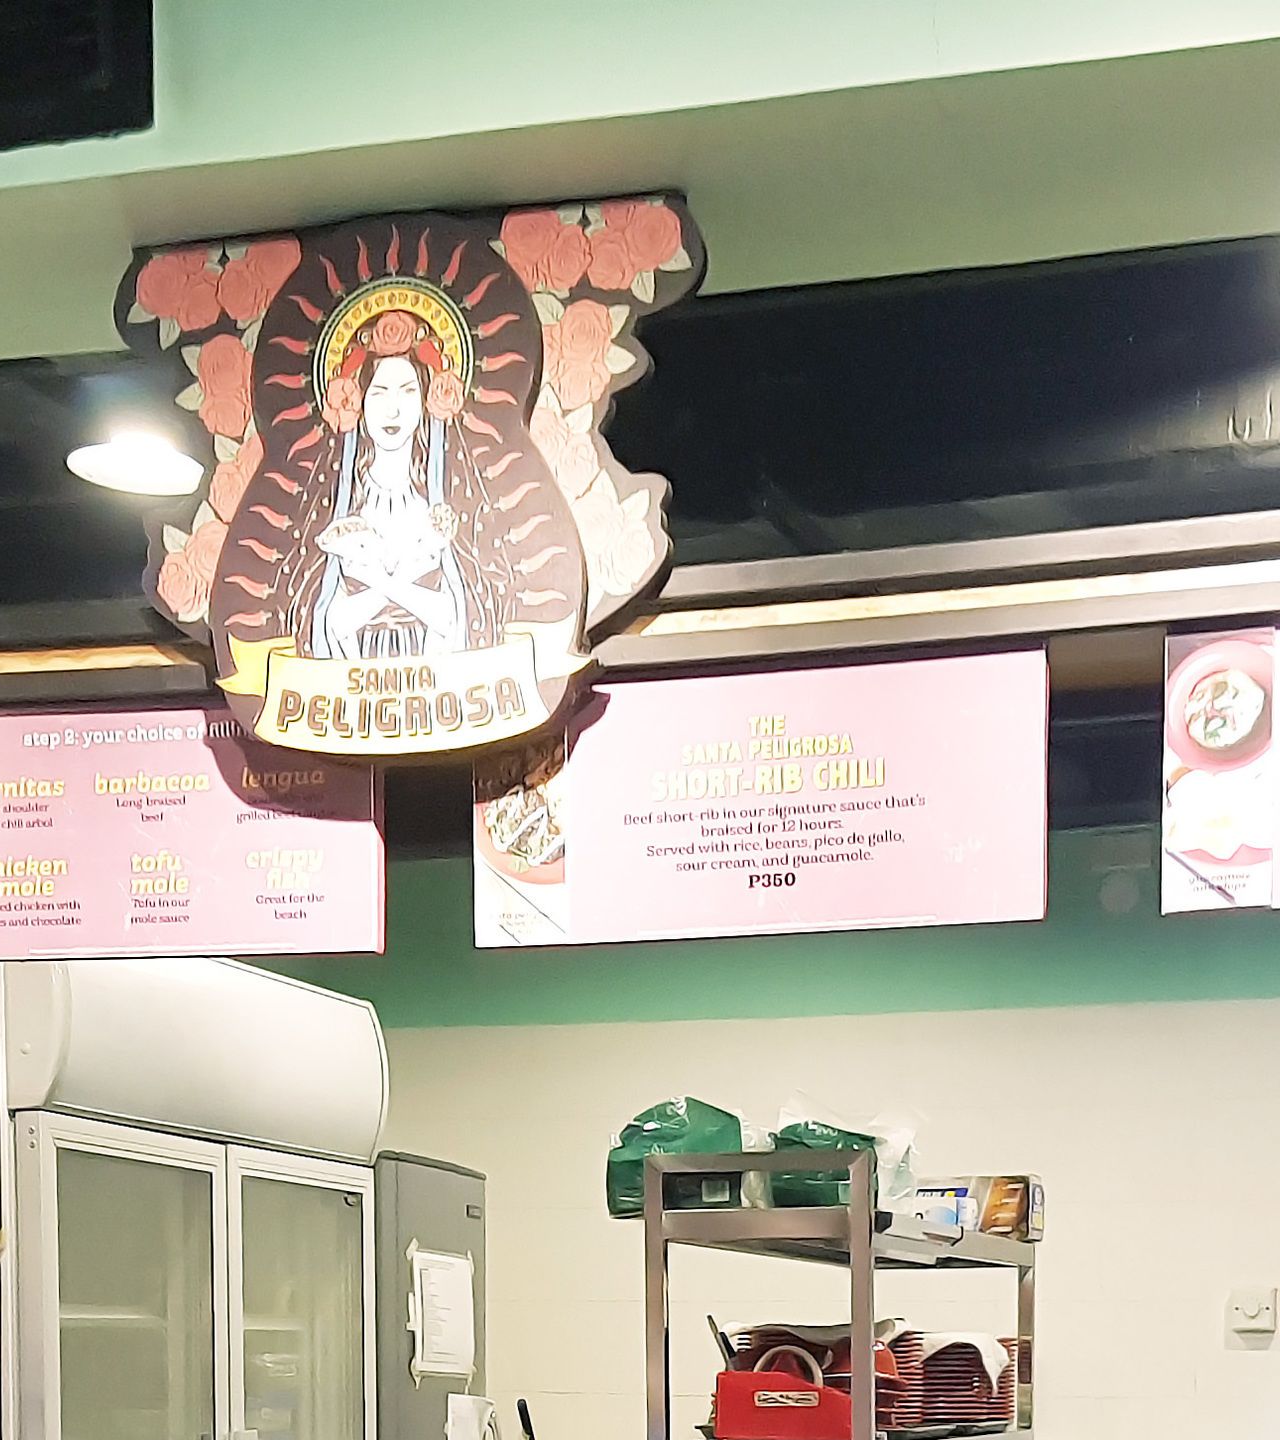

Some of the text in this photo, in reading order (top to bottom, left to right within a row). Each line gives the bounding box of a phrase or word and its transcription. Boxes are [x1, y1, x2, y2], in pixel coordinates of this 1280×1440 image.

[348, 665, 436, 695] SANTA
[276, 677, 526, 739] PELIGROSA
[23, 731, 61, 750] step
[64, 728, 80, 746] 2:
[81, 729, 122, 749] your
[126, 723, 183, 743] choice
[187, 721, 207, 740] of
[748, 714, 786, 737] THE
[680, 733, 854, 766] SANTA PELIGROSA
[94, 771, 210, 795] barbacoa
[241, 766, 325, 793] lengua
[650, 756, 886, 802] SHORT-RIB CHILI
[656, 808, 720, 824] short-rib
[722, 807, 736, 820] in
[739, 806, 763, 819] our
[767, 799, 837, 819] signature
[839, 799, 881, 812] sauce
[885, 793, 926, 809] that's
[700, 821, 753, 838] braised
[757, 820, 778, 835] for
[781, 819, 796, 833] 12
[646, 841, 695, 857] Served
[697, 839, 729, 855] with
[813, 834, 844, 853] pico
[847, 832, 865, 845] de
[868, 830, 906, 848] gallo,
[130, 848, 183, 873] tofu
[676, 859, 707, 872] sour
[762, 853, 789, 867] and
[792, 849, 875, 869] guacamole.
[130, 871, 190, 894] mole
[748, 871, 797, 889] P350
[14, 900, 54, 911] chicken
[57, 899, 81, 910] with
[8, 917, 29, 927] and
[30, 915, 82, 927] chocolate
